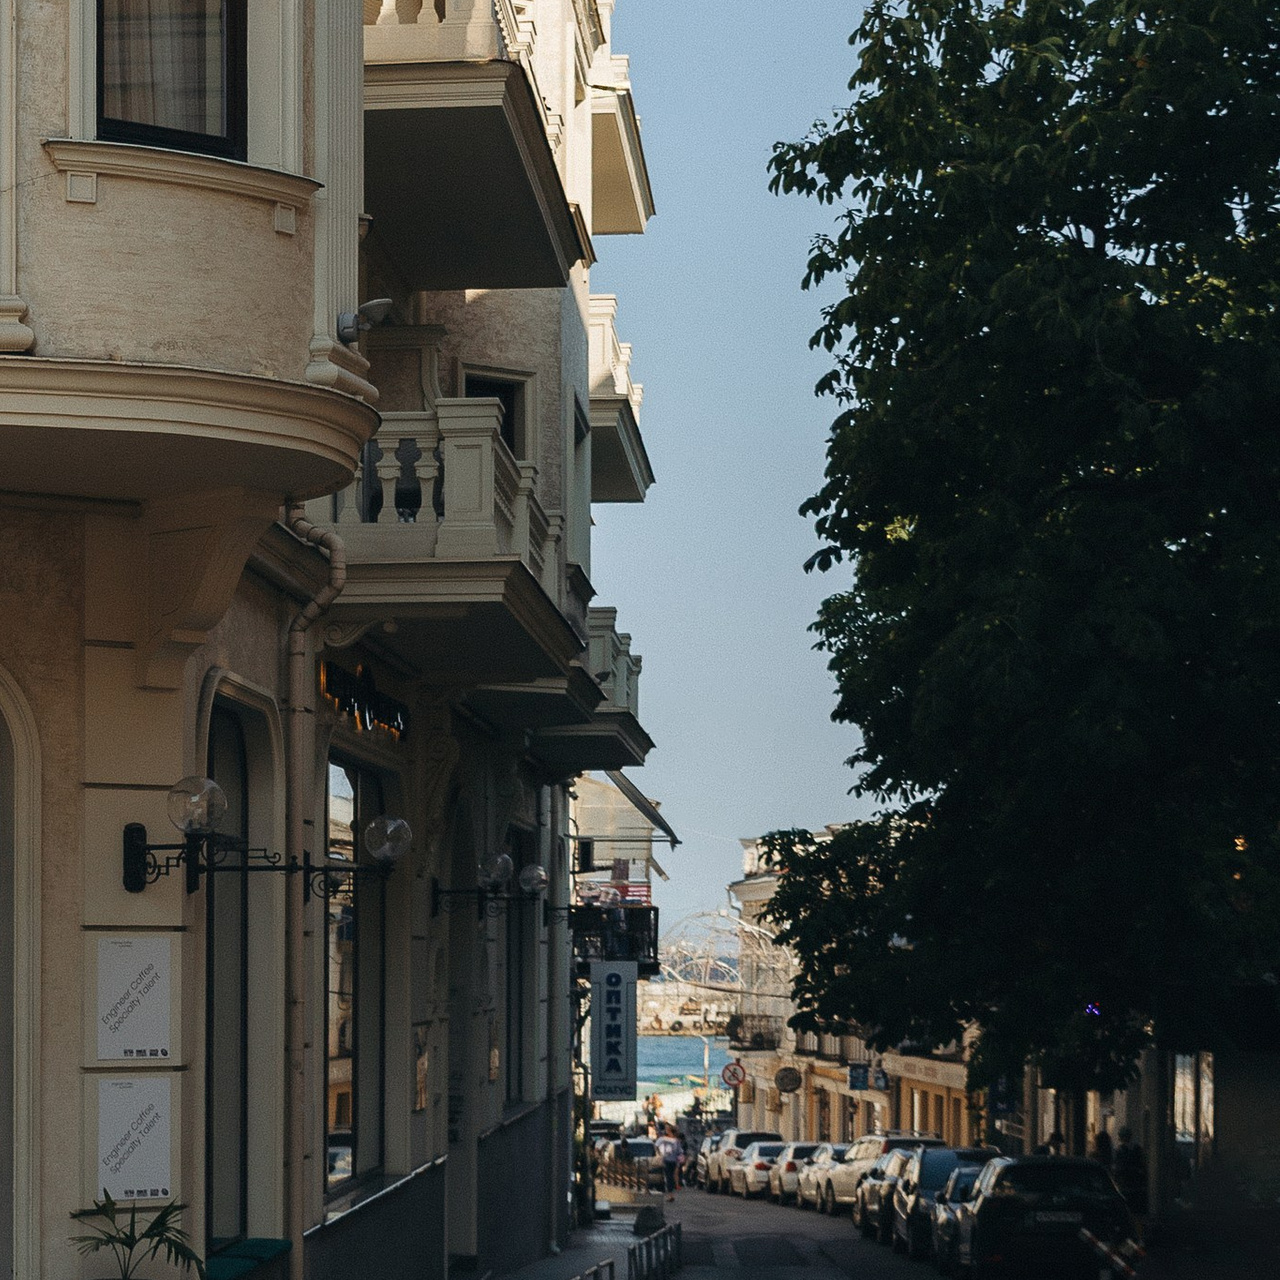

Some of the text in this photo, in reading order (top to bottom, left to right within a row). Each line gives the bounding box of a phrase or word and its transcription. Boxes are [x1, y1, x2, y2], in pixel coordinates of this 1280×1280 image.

[101, 963, 155, 1025] Engineer Coffee
[109, 997, 142, 1034] Specialty
[139, 972, 162, 998] Talent
[605, 972, 622, 1073] ОПТИКА
[102, 1102, 156, 1167] Engineer Coffee
[109, 1137, 142, 1175] Specialty
[139, 1111, 162, 1138] Talent
